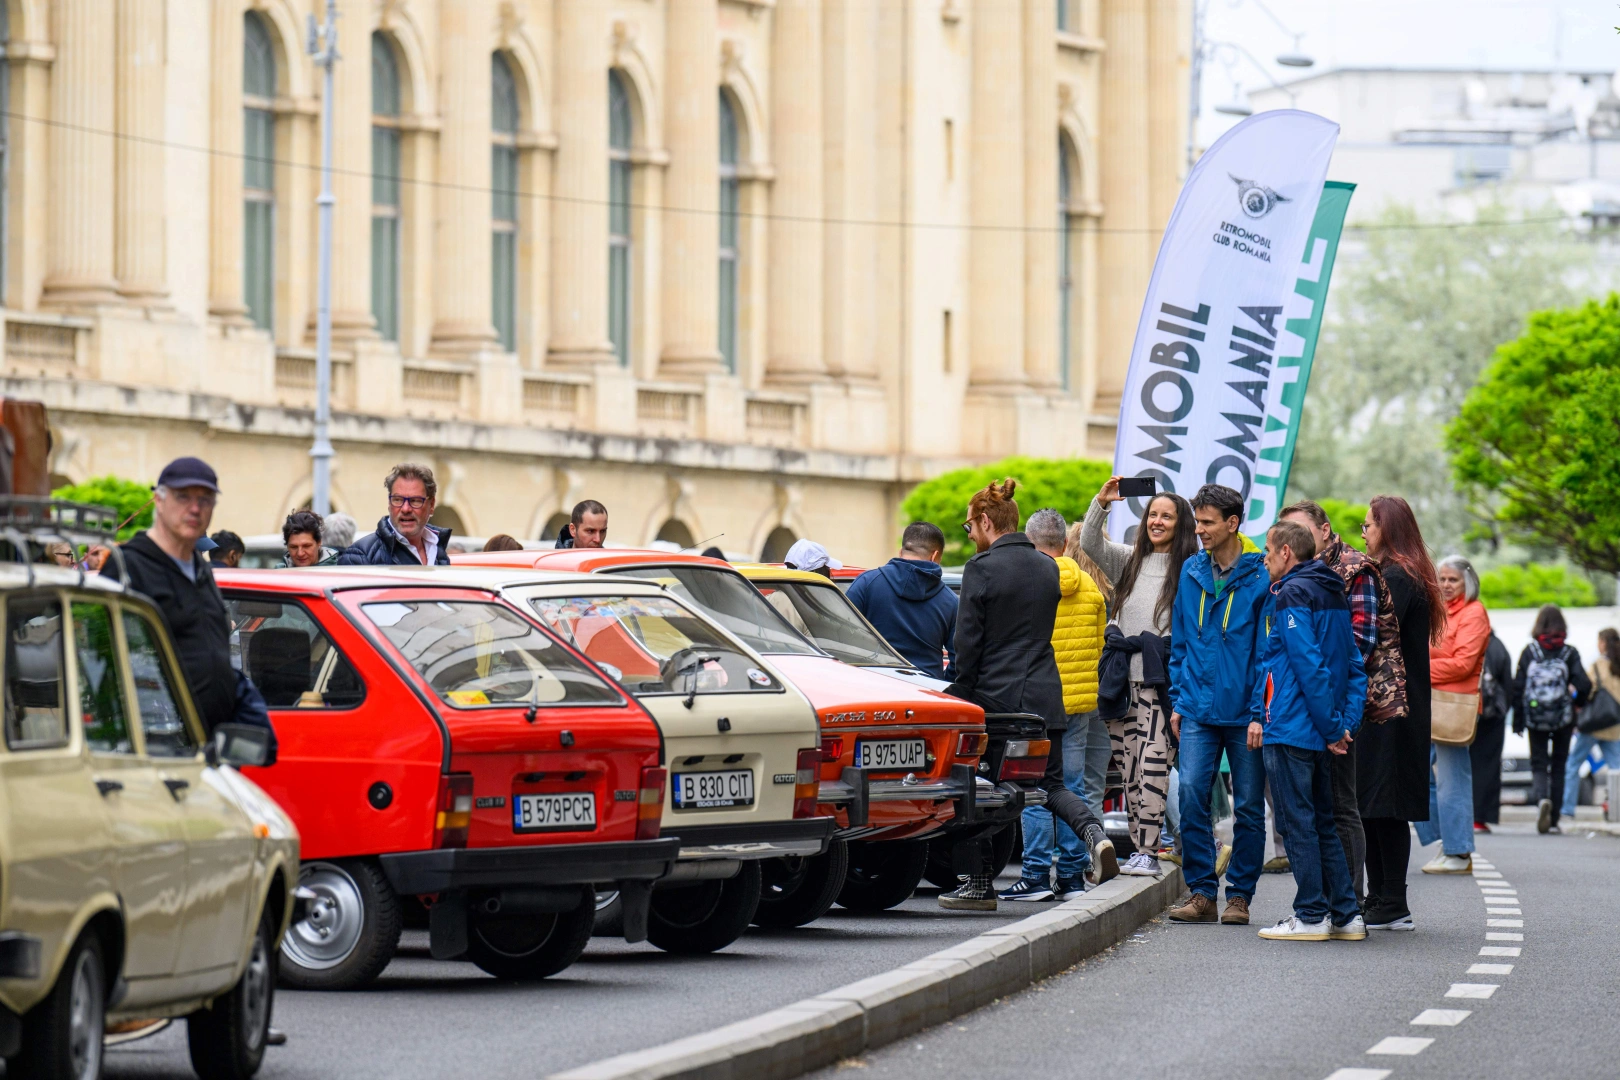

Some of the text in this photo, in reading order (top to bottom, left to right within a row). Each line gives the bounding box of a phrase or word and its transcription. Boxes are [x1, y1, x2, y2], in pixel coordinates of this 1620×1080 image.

[1220, 221, 1271, 249] RETROMOBIL
[1213, 233, 1271, 263] CLUB ROMANIA
[825, 711, 866, 723] DACIA
[862, 744, 871, 766] B
[876, 743, 897, 766] 975
[899, 742, 923, 765] UAP
[685, 773, 748, 800] B 830 CIT
[522, 800, 532, 824] B
